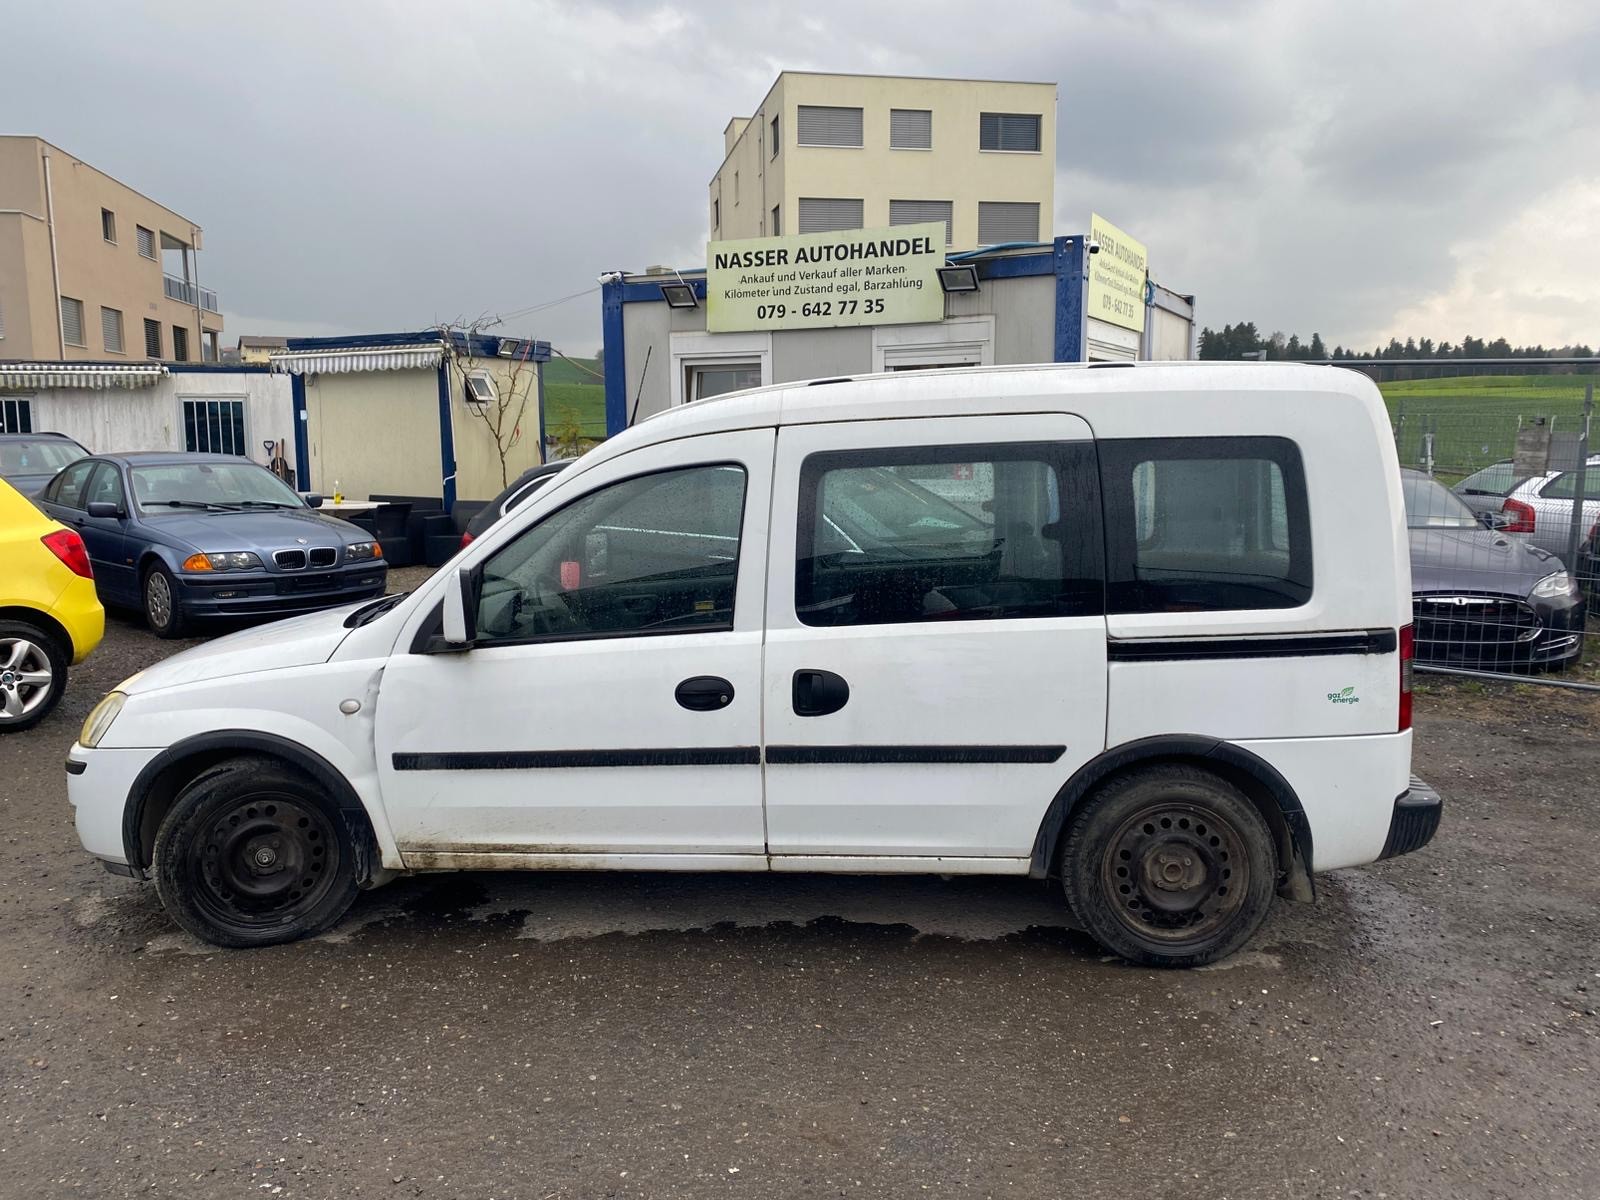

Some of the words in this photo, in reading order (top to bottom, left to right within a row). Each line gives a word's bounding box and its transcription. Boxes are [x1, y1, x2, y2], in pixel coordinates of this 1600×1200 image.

[715, 248, 789, 270] NASSER
[795, 236, 936, 264] AUTOHANDEL
[1093, 228, 1115, 255] NASSER
[1115, 243, 1145, 273] AUTOHANDEL
[740, 272, 775, 285] Ankauf
[777, 271, 796, 282] und
[799, 268, 838, 280] Verkauf
[840, 266, 863, 277] aller
[865, 264, 905, 276] Marken
[724, 288, 770, 299] Kilometer
[772, 285, 791, 296] und
[794, 282, 833, 294] Zustand
[836, 281, 861, 294] egal,
[864, 278, 923, 291] Barzahlung
[757, 304, 787, 319] 079
[801, 302, 832, 317] 642
[838, 300, 858, 315] 77
[863, 298, 885, 314] 35
[1103, 294, 1112, 311] 079
[1114, 298, 1123, 314] 642
[1123, 301, 1128, 317] 77
[1128, 303, 1134, 319] 35
[1332, 696, 1360, 704] energie
